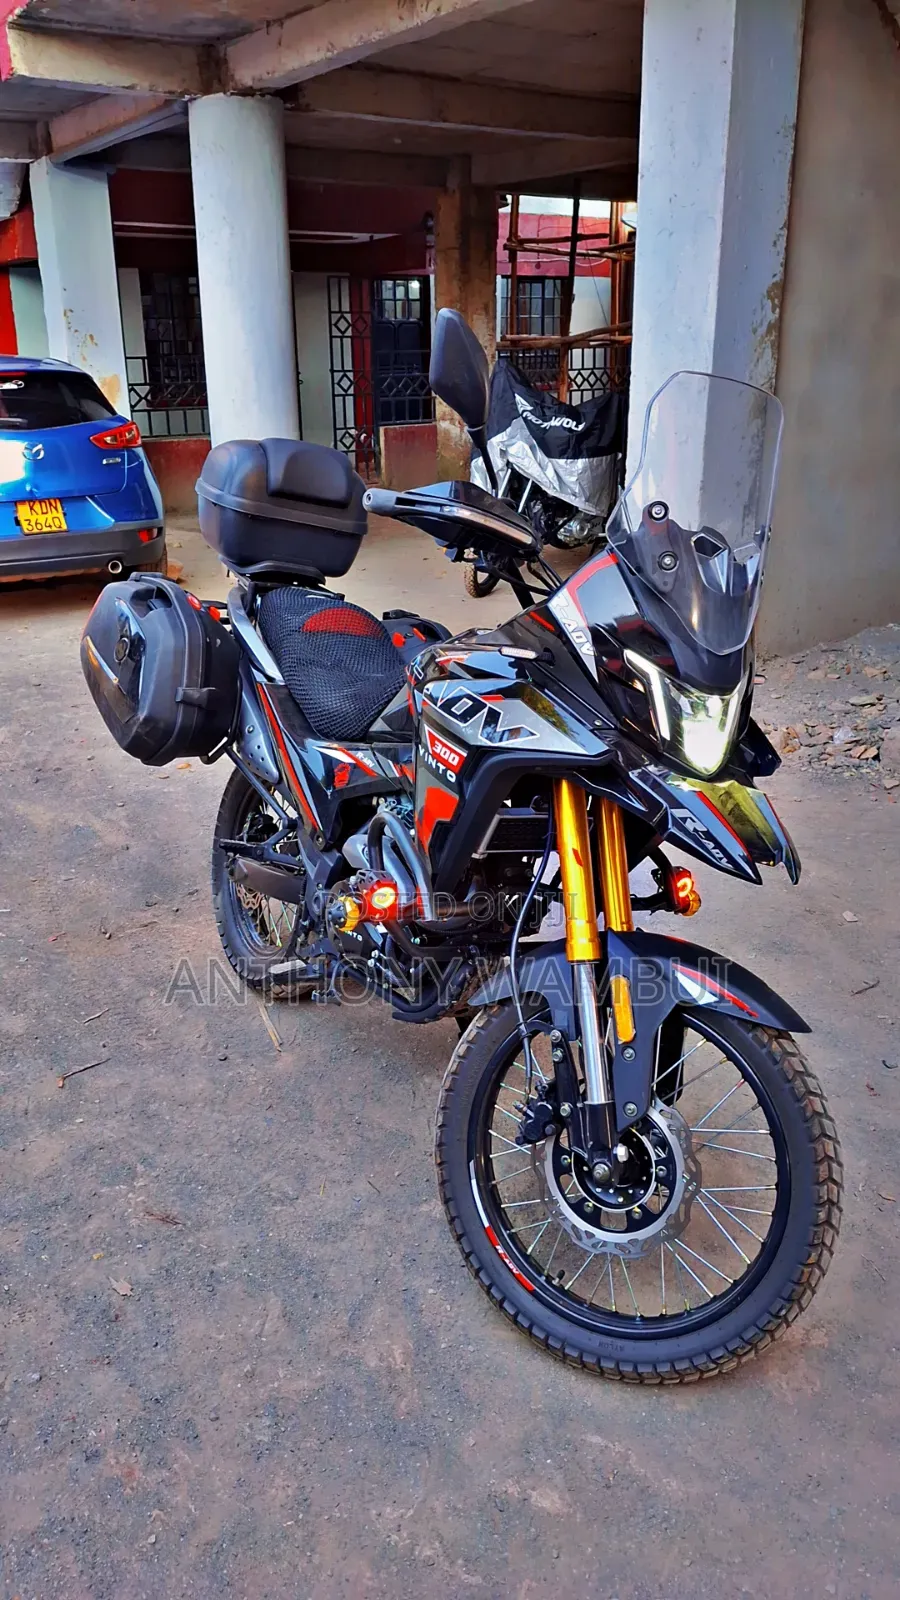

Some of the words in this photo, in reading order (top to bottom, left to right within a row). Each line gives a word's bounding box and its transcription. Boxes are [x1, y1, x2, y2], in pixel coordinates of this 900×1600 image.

[28, 499, 59, 515] KDN
[24, 517, 63, 532] 364Q
[418, 744, 457, 783] VINTO
[433, 741, 460, 766] 300
[670, 808, 735, 869] R-ADV
